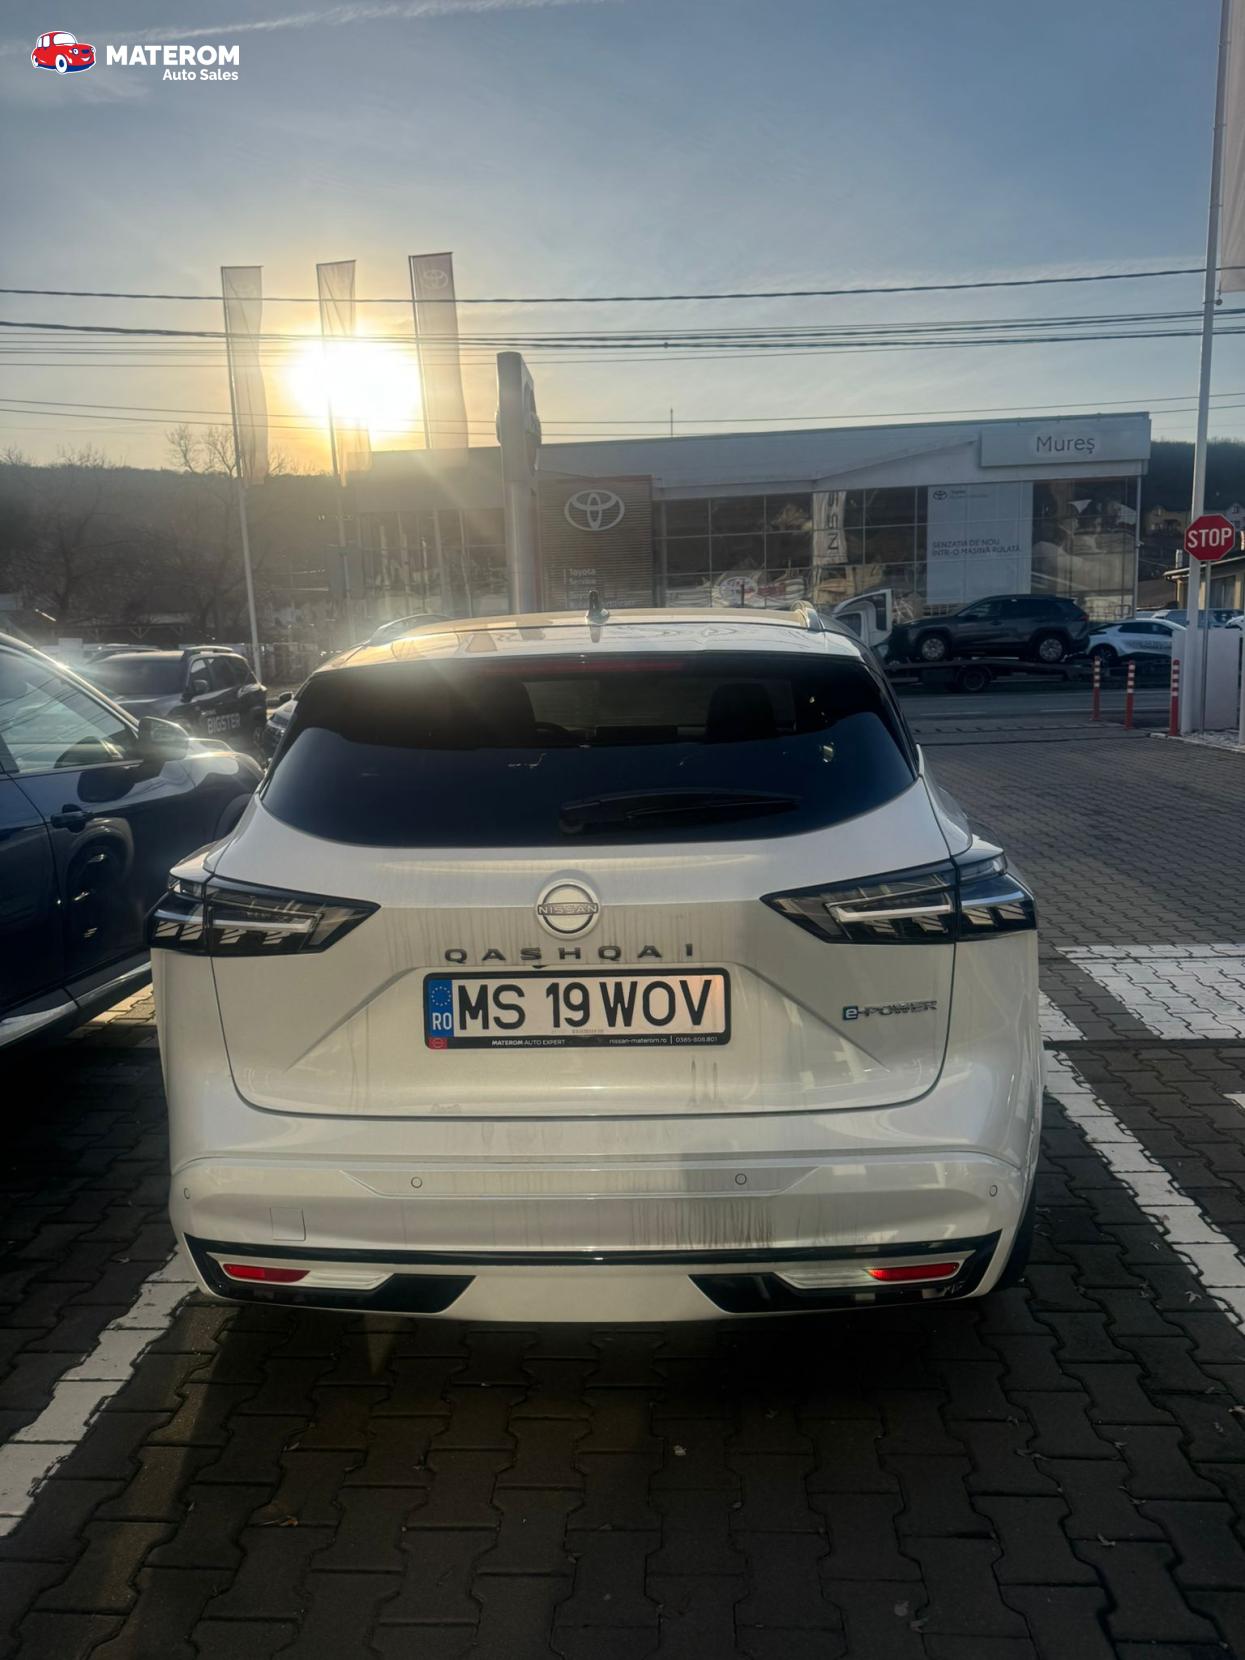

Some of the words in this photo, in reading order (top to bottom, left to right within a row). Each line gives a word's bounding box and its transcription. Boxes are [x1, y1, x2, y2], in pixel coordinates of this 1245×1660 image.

[1036, 435, 1096, 455] Mureș
[1187, 527, 1232, 549] STOP
[538, 904, 597, 914] NISSAN
[445, 943, 694, 964] QASHQAI
[432, 1012, 453, 1031] RO
[457, 983, 526, 1031] MS
[546, 981, 591, 1029] 19
[599, 979, 712, 1028] WOV
[542, 1038, 565, 1046] EXPERT
